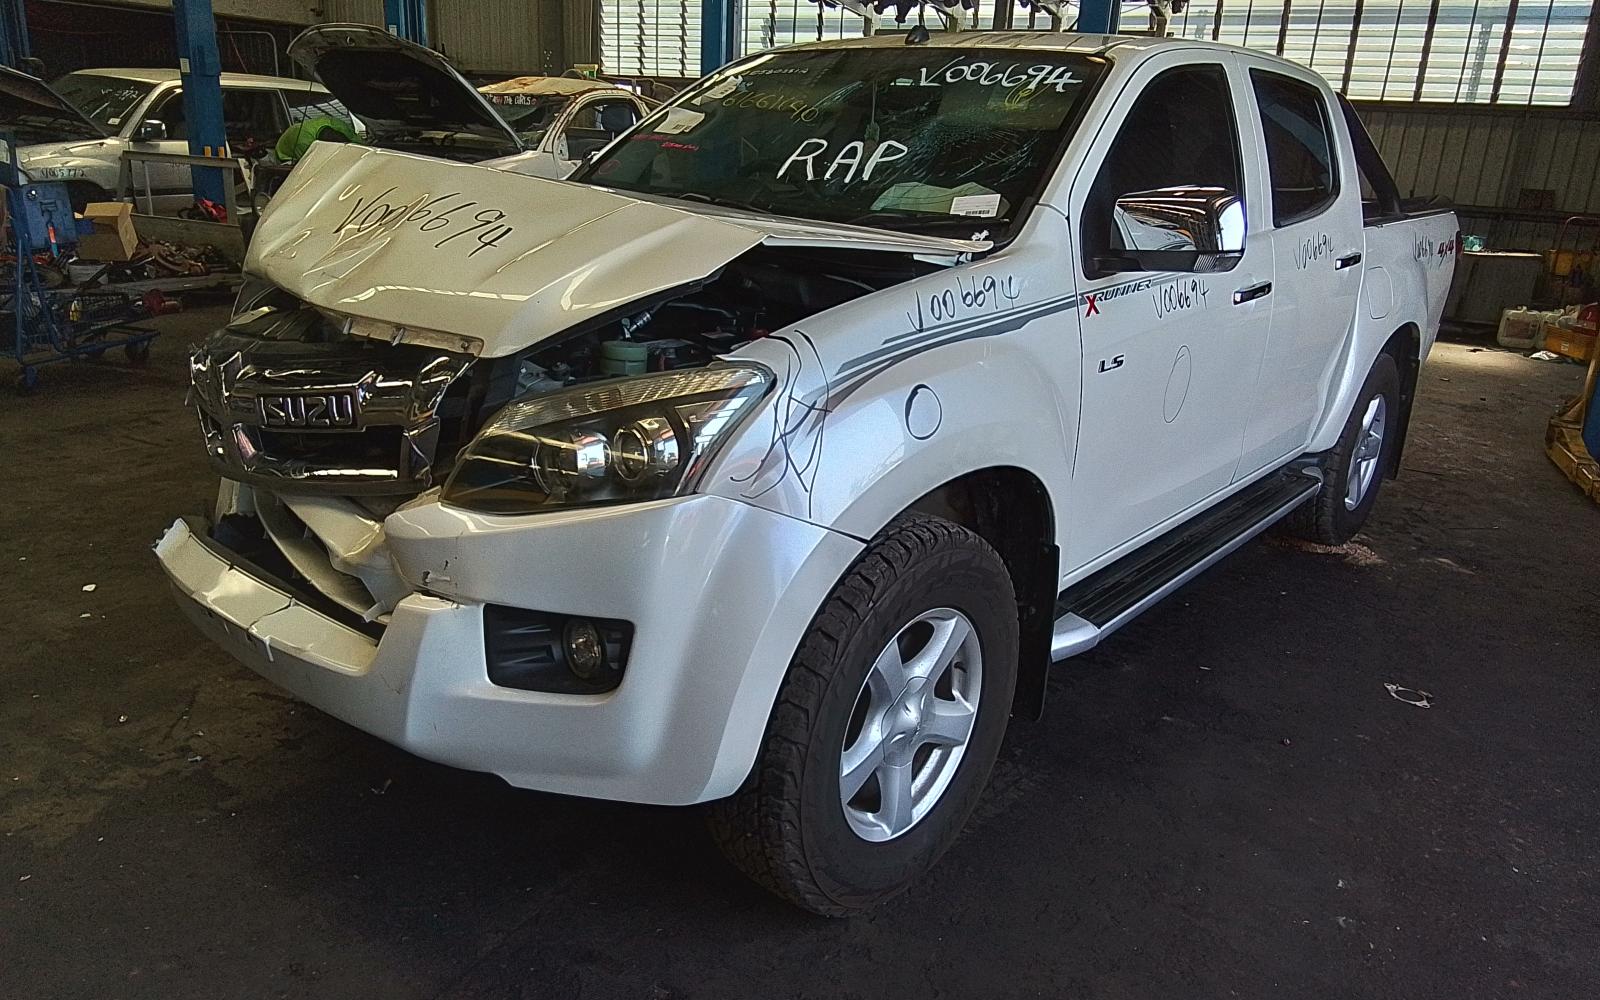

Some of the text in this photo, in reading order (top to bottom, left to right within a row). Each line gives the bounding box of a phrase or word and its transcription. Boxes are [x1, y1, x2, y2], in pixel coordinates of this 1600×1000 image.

[919, 56, 1083, 92] V006694
[776, 139, 908, 183] RAP
[333, 186, 513, 258] V006694
[1294, 231, 1334, 270] V006694
[907, 274, 1020, 333] V006694
[1152, 277, 1210, 319] V006694
[1098, 354, 1125, 373] LS
